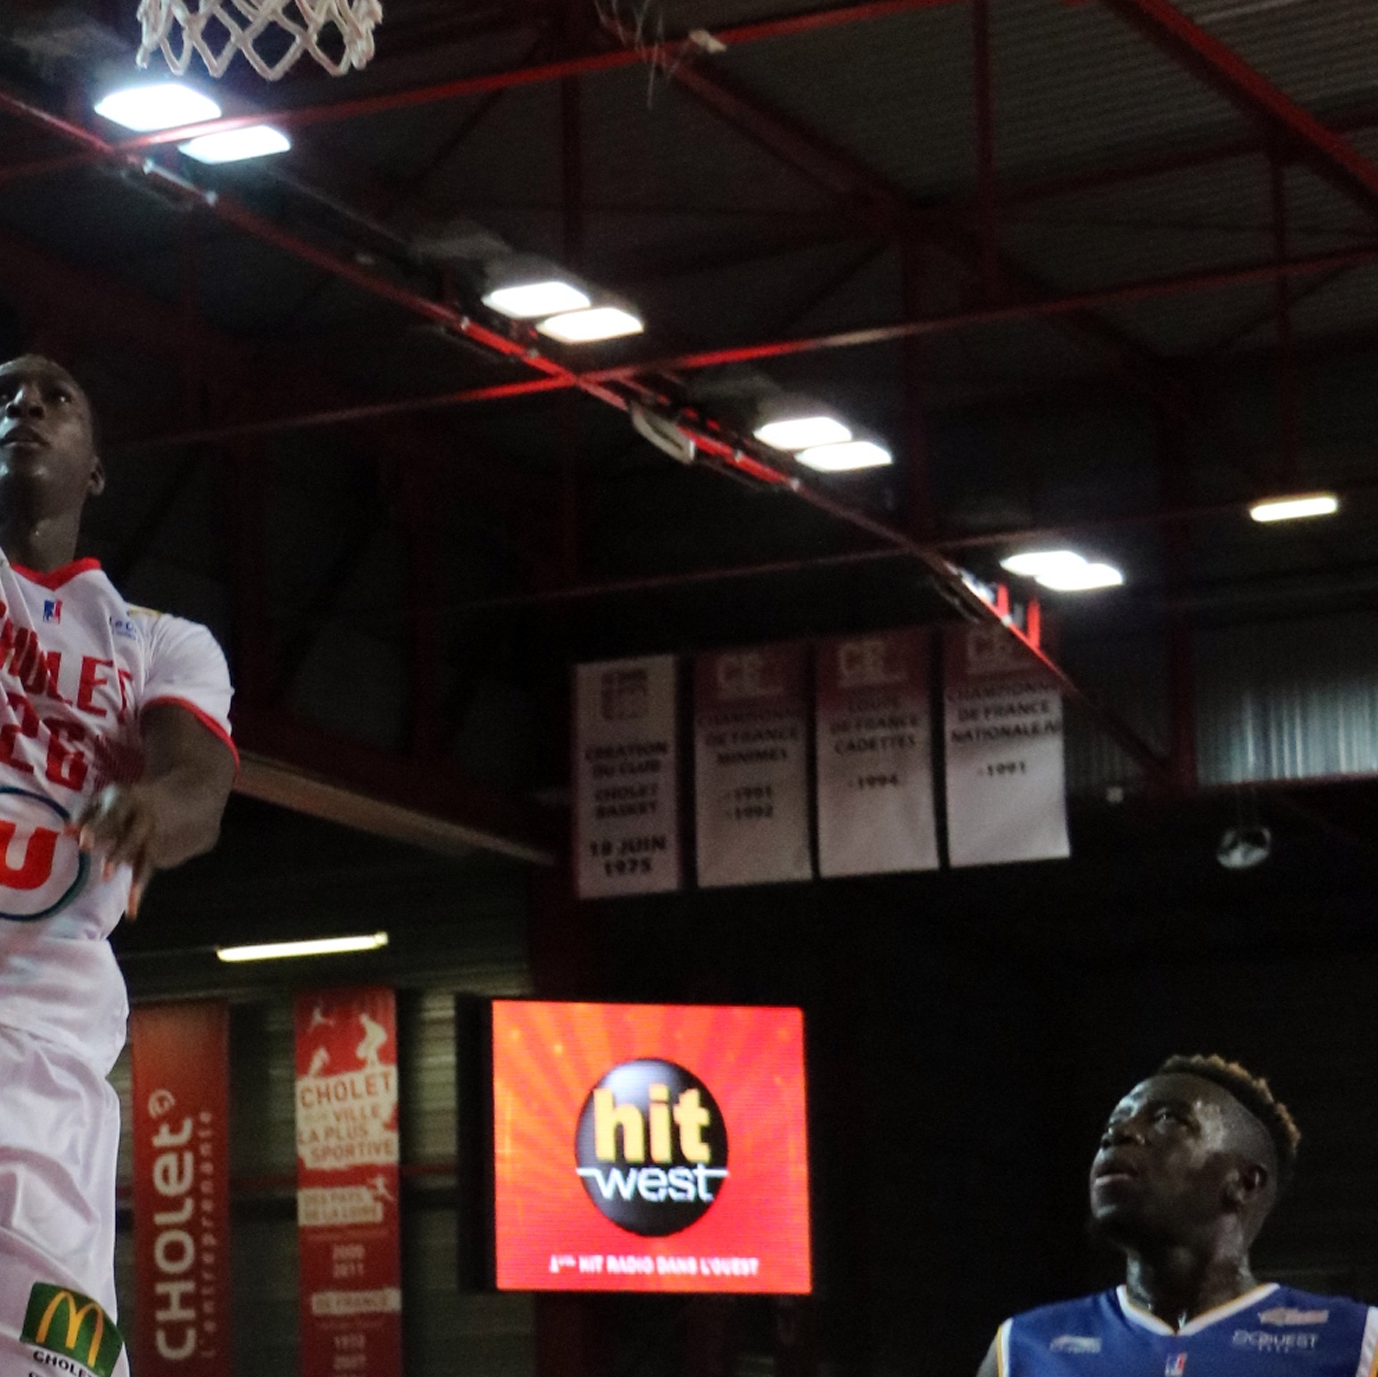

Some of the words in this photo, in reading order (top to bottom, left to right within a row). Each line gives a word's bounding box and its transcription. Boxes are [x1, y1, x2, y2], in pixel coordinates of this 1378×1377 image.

[301, 1071, 391, 1109] CHOLET
[592, 1083, 711, 1164] hit
[310, 1138, 393, 1163] SPORTIVE
[577, 1163, 729, 1202] west
